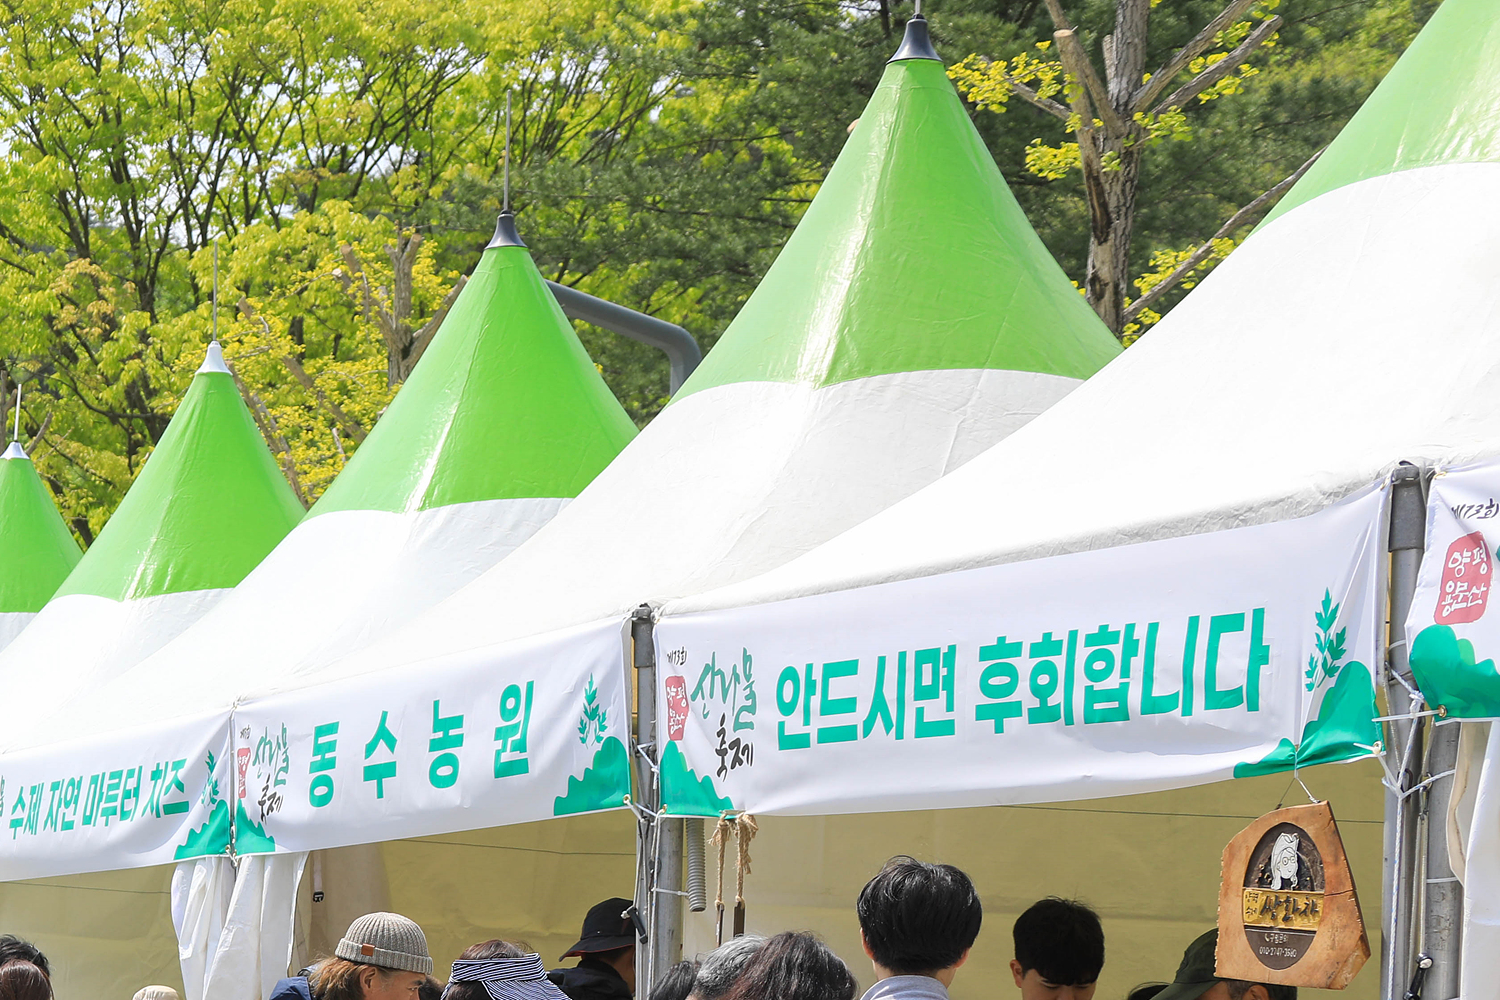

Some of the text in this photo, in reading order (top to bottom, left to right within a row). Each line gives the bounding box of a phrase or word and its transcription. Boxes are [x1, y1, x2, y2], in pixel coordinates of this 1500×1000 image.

[1448, 540, 1489, 578] 양평
[1440, 580, 1488, 618] 용문산
[775, 606, 1271, 752] 안드시면 후회합니다
[714, 712, 755, 782] 축제
[8, 782, 45, 841] 수제
[43, 774, 84, 834] 자연
[141, 757, 190, 819] 치즈
